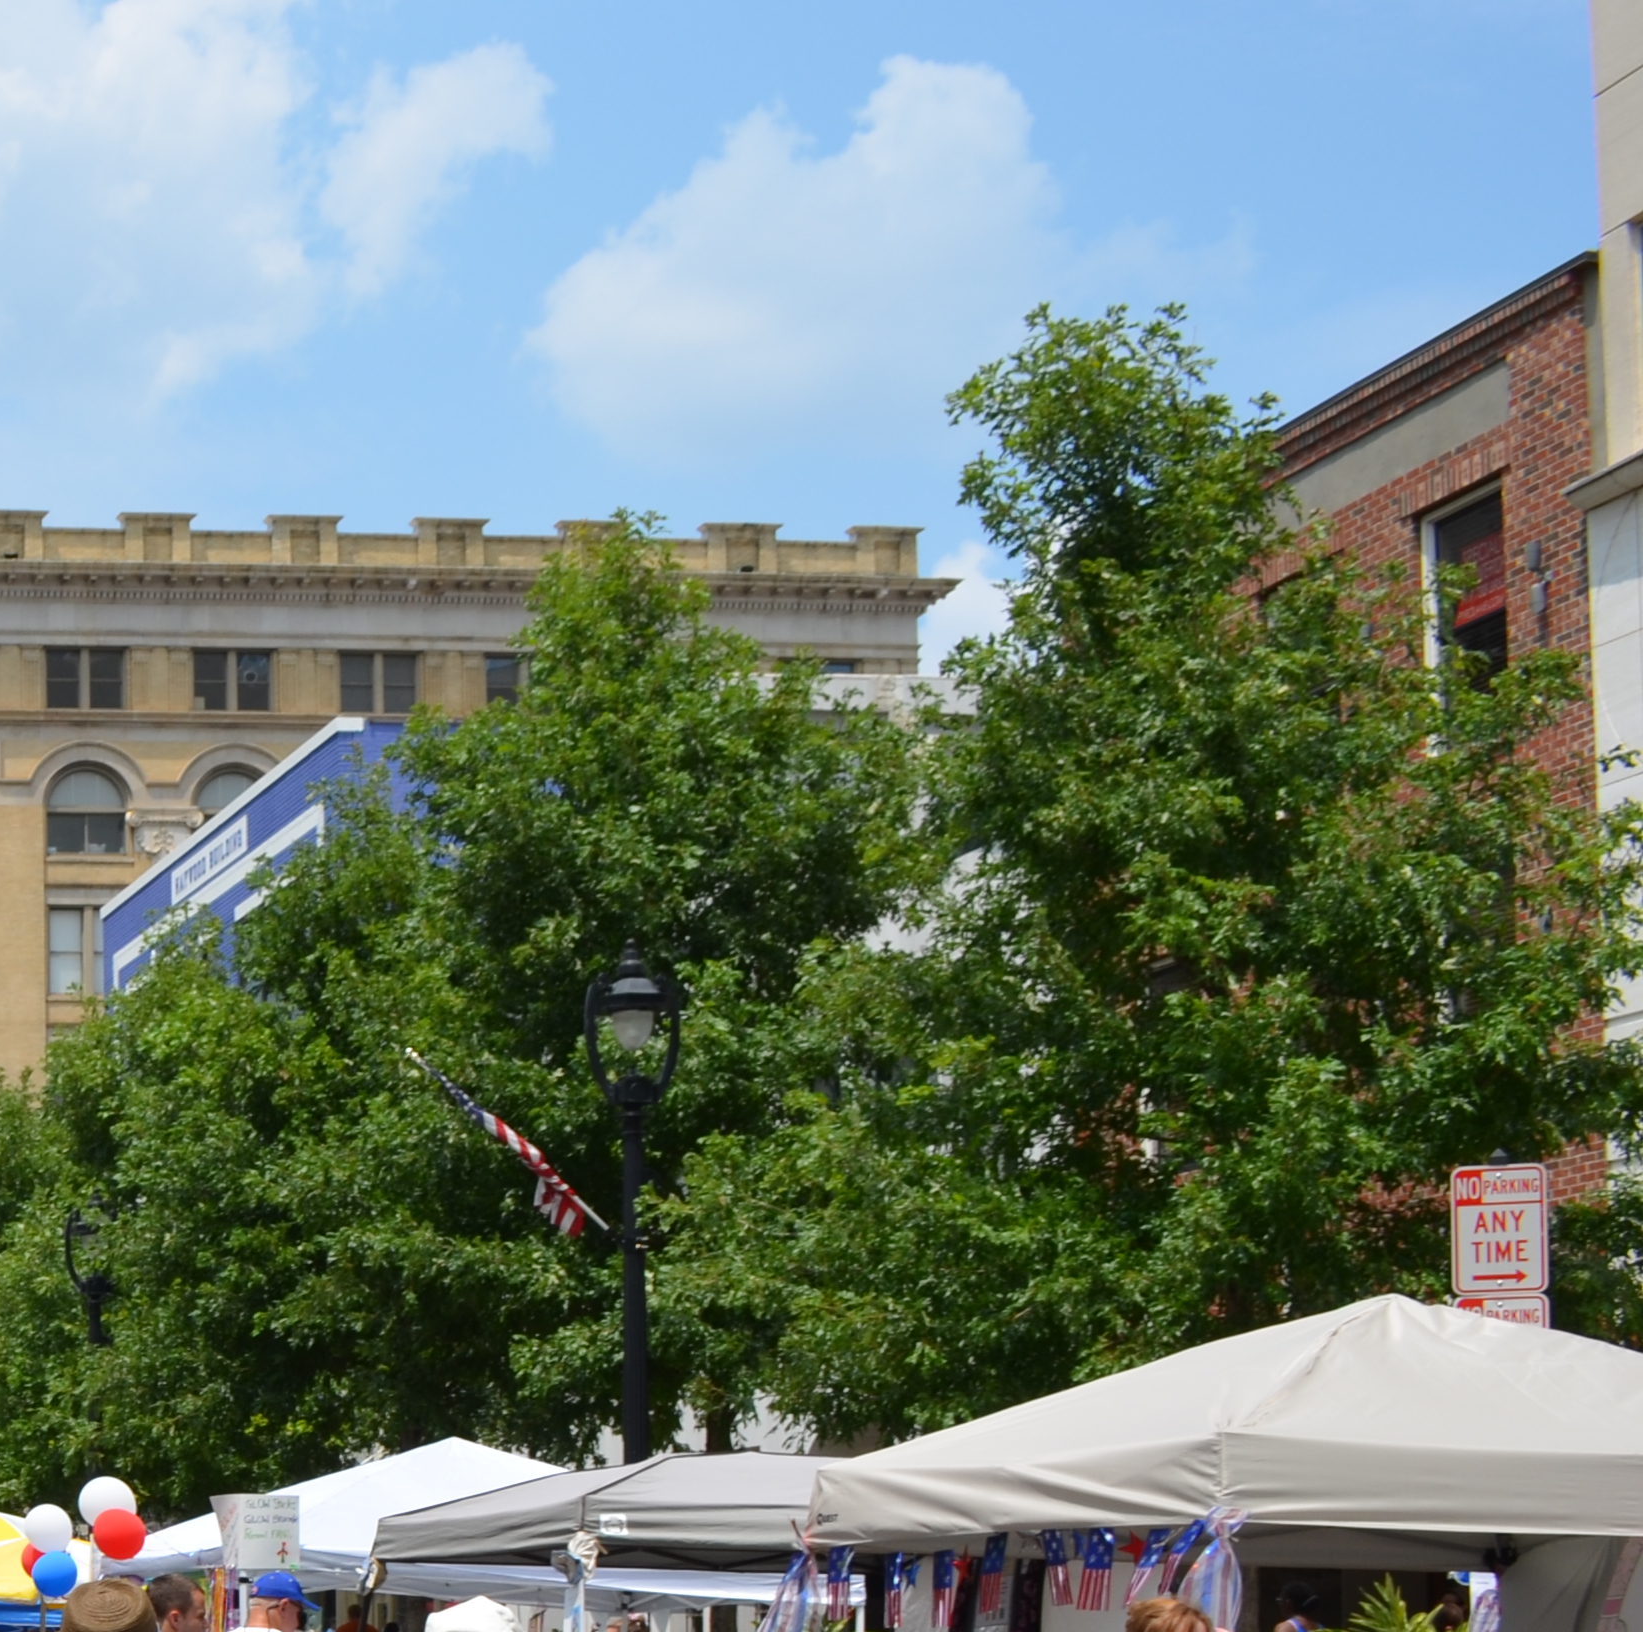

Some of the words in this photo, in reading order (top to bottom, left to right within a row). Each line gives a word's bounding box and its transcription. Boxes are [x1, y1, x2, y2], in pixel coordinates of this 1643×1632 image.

[209, 828, 242, 869] BUILDING
[1456, 1177, 1481, 1200] NO
[1483, 1178, 1540, 1195] PARKING
[1474, 1209, 1525, 1234] ANY
[1471, 1239, 1529, 1263] TIME
